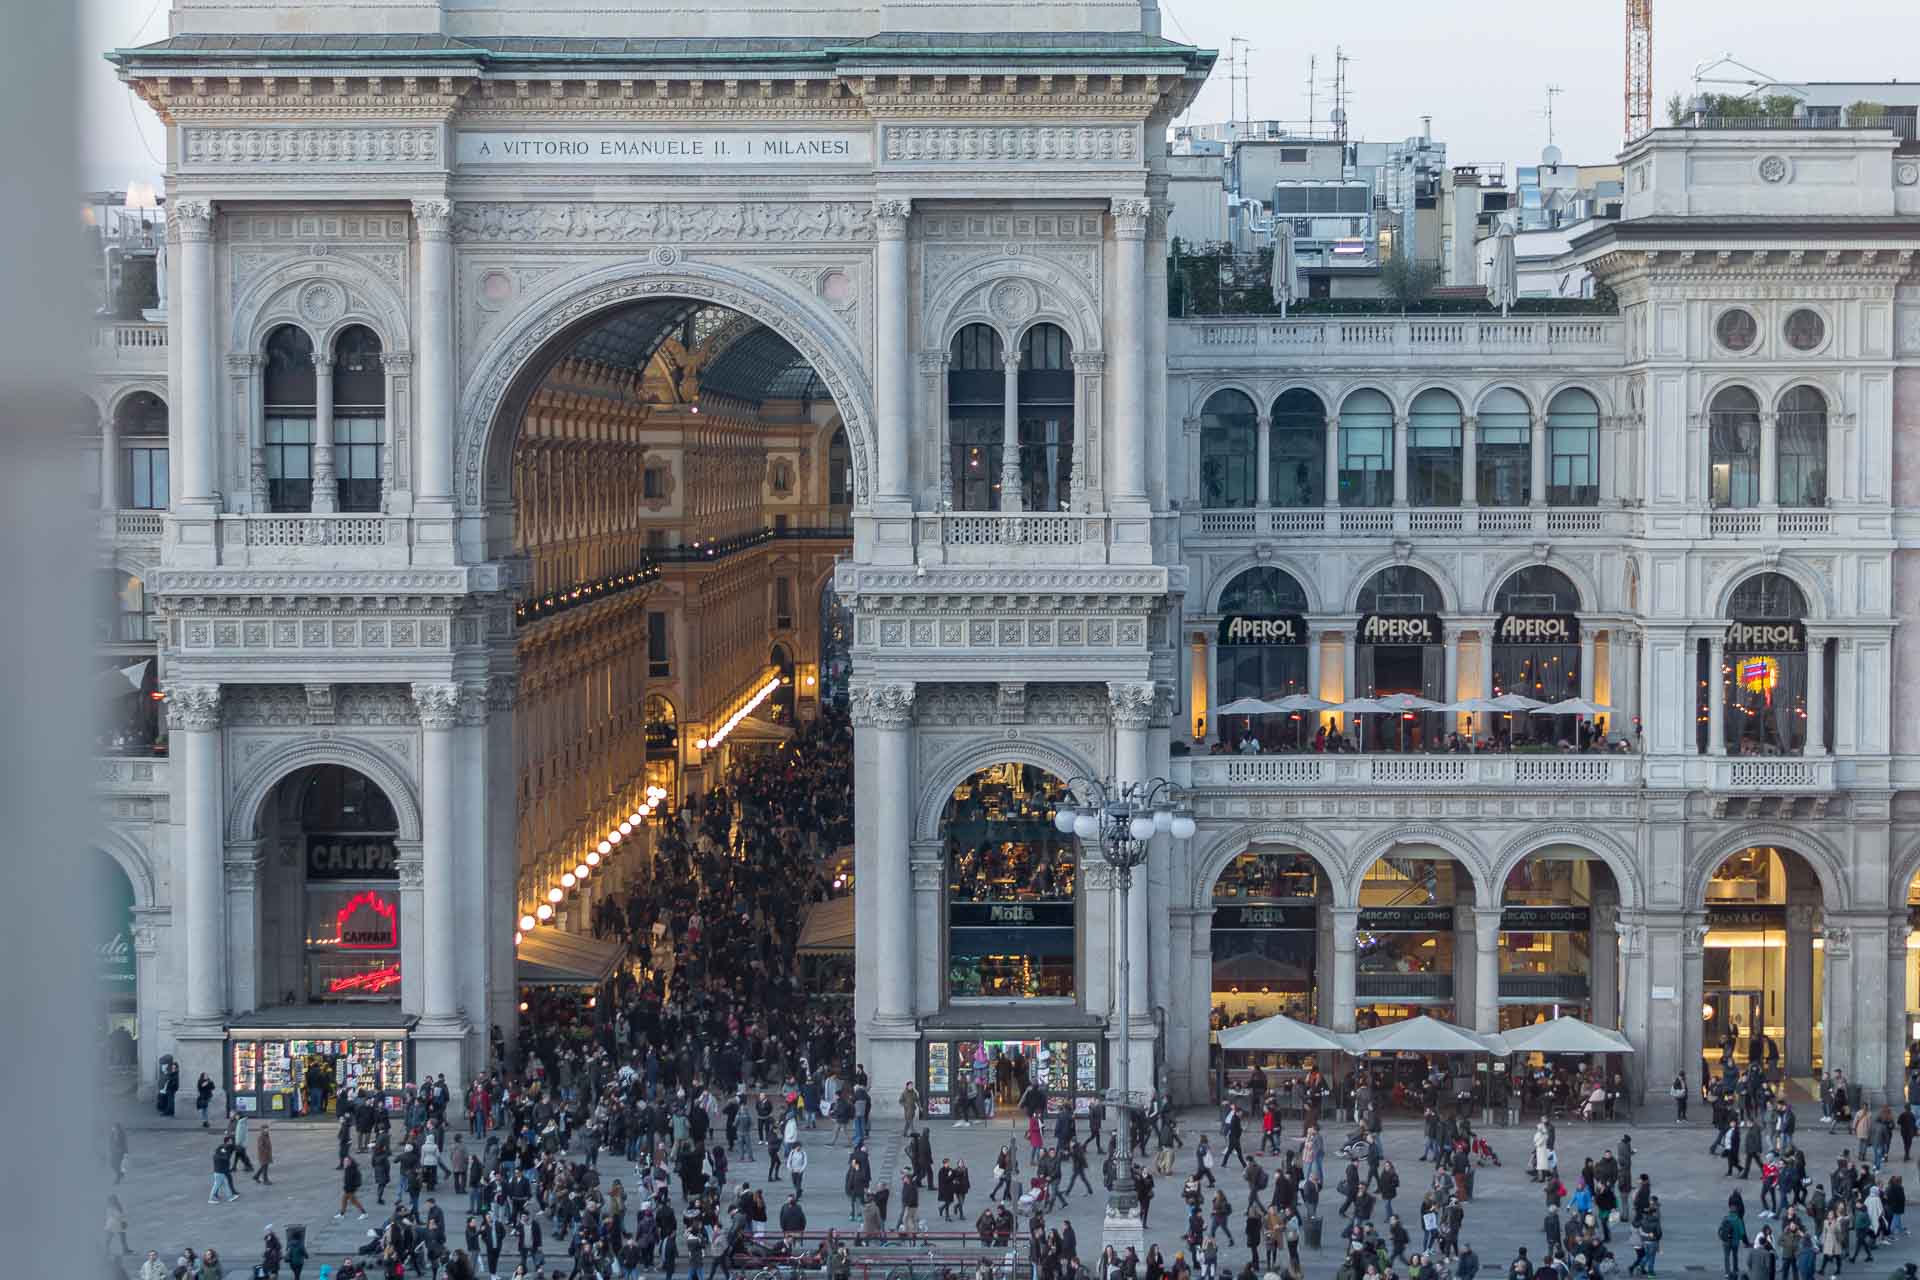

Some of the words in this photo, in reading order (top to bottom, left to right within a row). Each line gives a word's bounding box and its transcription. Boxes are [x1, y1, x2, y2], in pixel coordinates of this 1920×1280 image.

[479, 141, 491, 155] A
[503, 141, 589, 155] VITTORIO
[600, 141, 704, 155] EMANUELE
[764, 141, 850, 155] MILANESI
[1228, 616, 1296, 637] APEROL
[1364, 616, 1432, 637] APEROL
[1501, 616, 1569, 637] APEROL
[1728, 622, 1798, 644] APEROL
